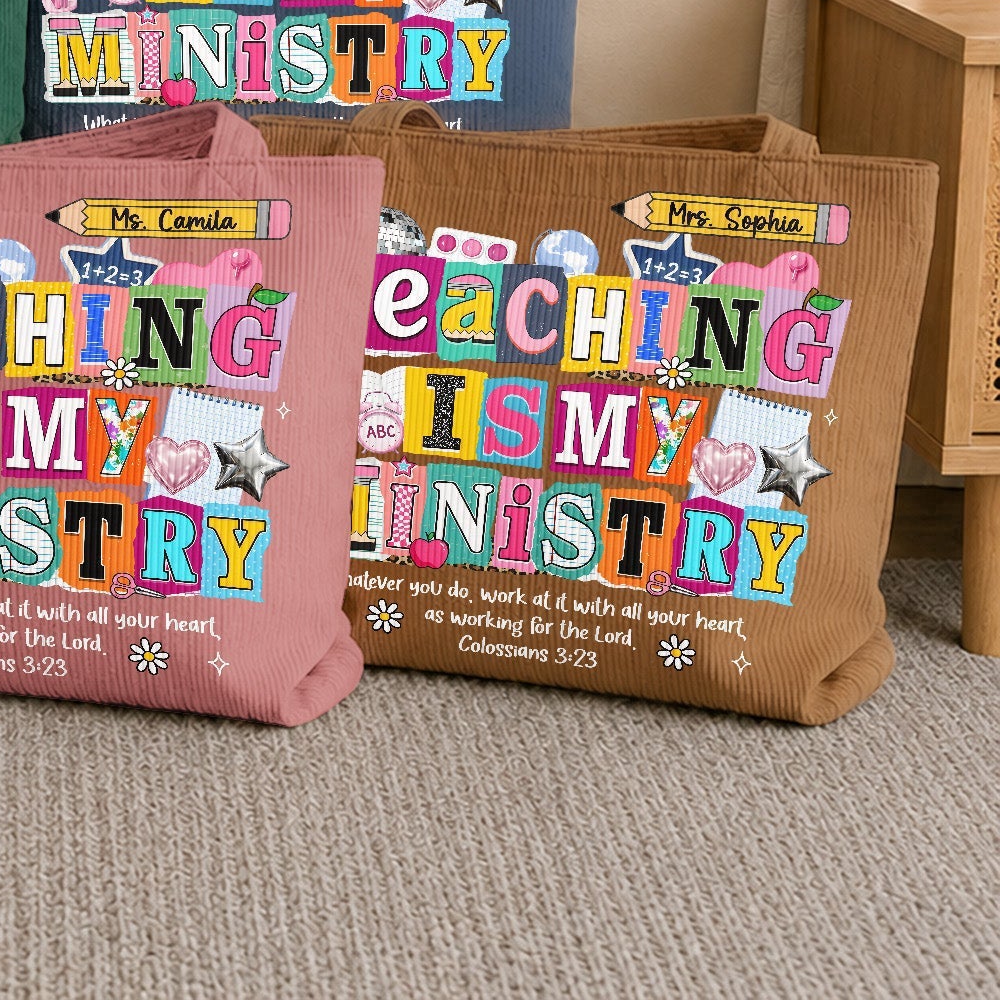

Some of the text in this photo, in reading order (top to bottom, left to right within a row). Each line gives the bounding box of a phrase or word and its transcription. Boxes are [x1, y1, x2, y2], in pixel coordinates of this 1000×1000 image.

[111, 208, 238, 232] Ms. Camila
[668, 202, 804, 239] Mrs. Sophia
[81, 262, 143, 287] 1+2=3
[642, 258, 703, 285] 1+2=3
[5, 395, 150, 476] MY
[366, 424, 396, 439] ABC
[422, 373, 701, 475] IS MY
[18, 600, 32, 620] it
[36, 602, 81, 623] with
[86, 606, 109, 625] all
[114, 612, 160, 630] your
[165, 612, 222, 642] heart,
[348, 570, 747, 642] atever you do, work at it with all your heart,
[24, 628, 56, 648] the
[62, 632, 107, 656] Lord.
[424, 608, 636, 651] as working for the Lord.
[22, 655, 68, 677] 3:23
[458, 634, 598, 670] Colossians 3:23
